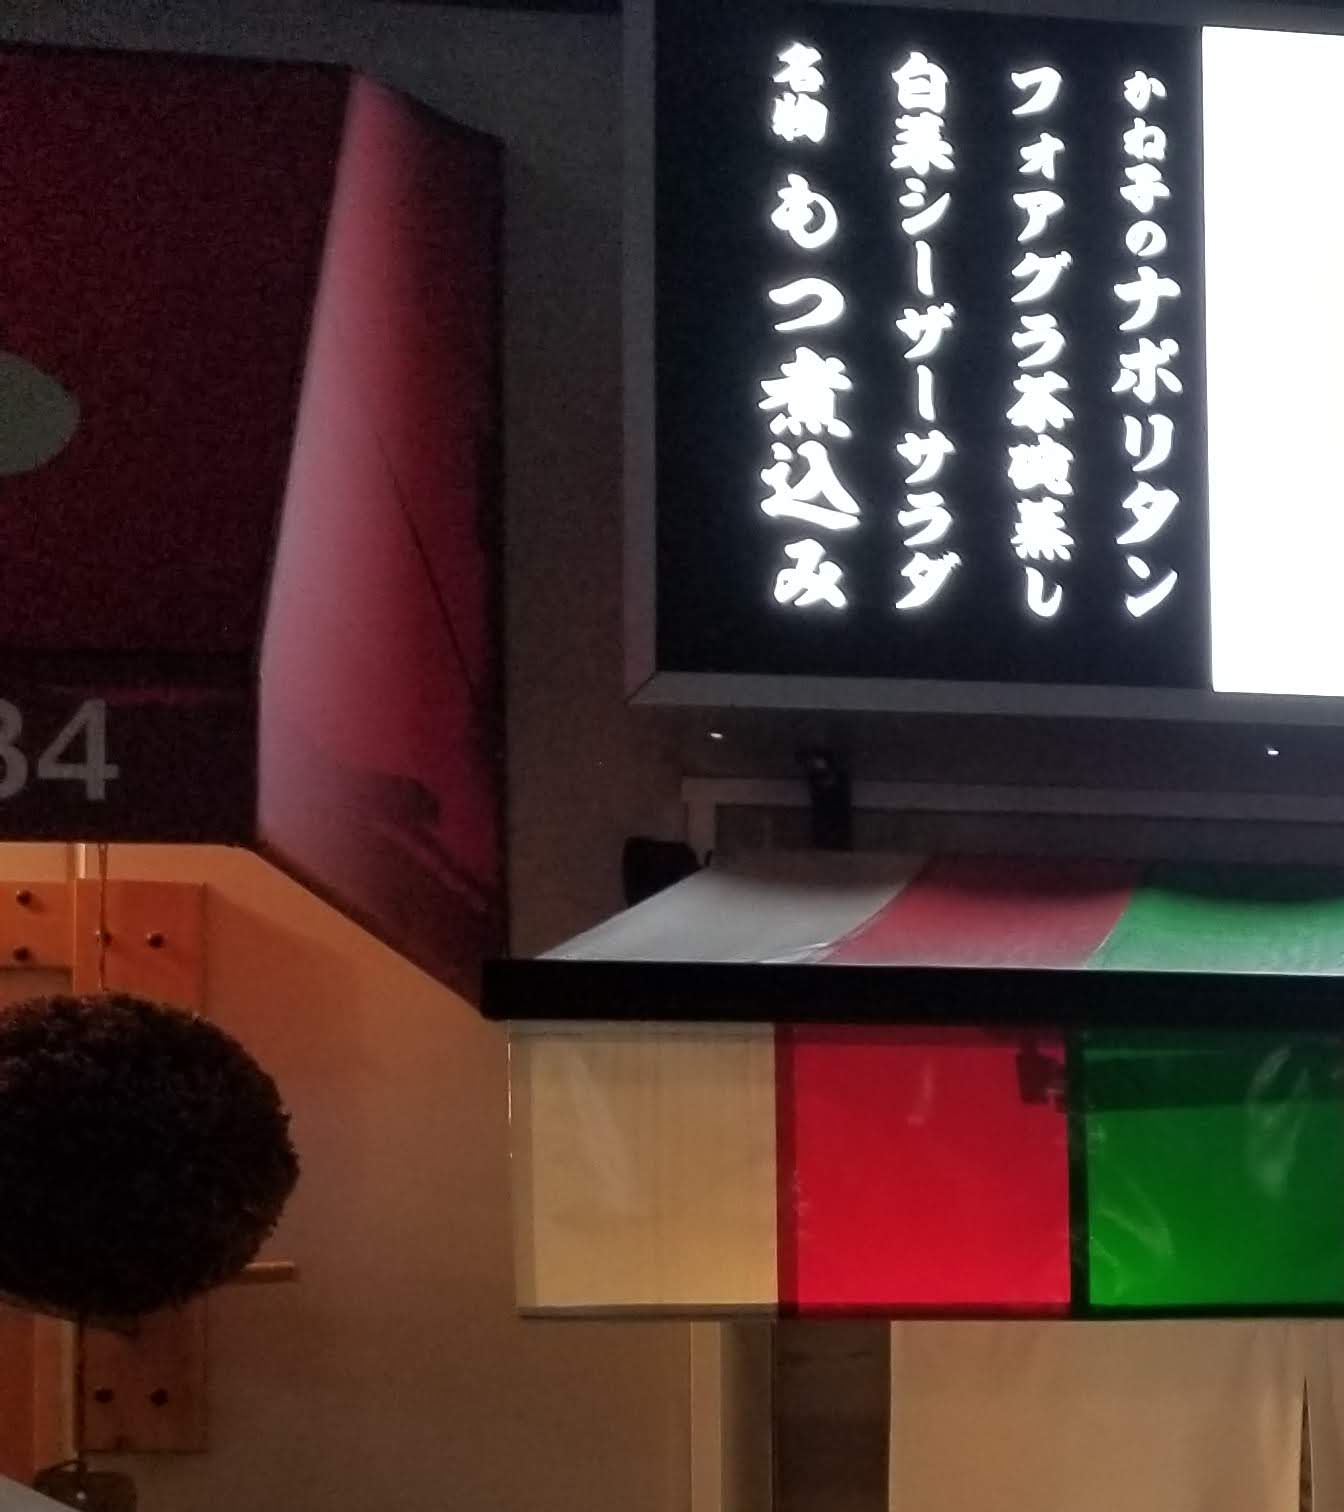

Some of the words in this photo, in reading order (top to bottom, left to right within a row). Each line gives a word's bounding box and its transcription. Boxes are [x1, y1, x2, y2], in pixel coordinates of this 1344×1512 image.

[891, 52, 961, 609] 白菜シーザーサラダ
[1008, 66, 1075, 618] フォアグラ茶碗蒸し
[1112, 71, 1182, 617] かね子のナポリタン
